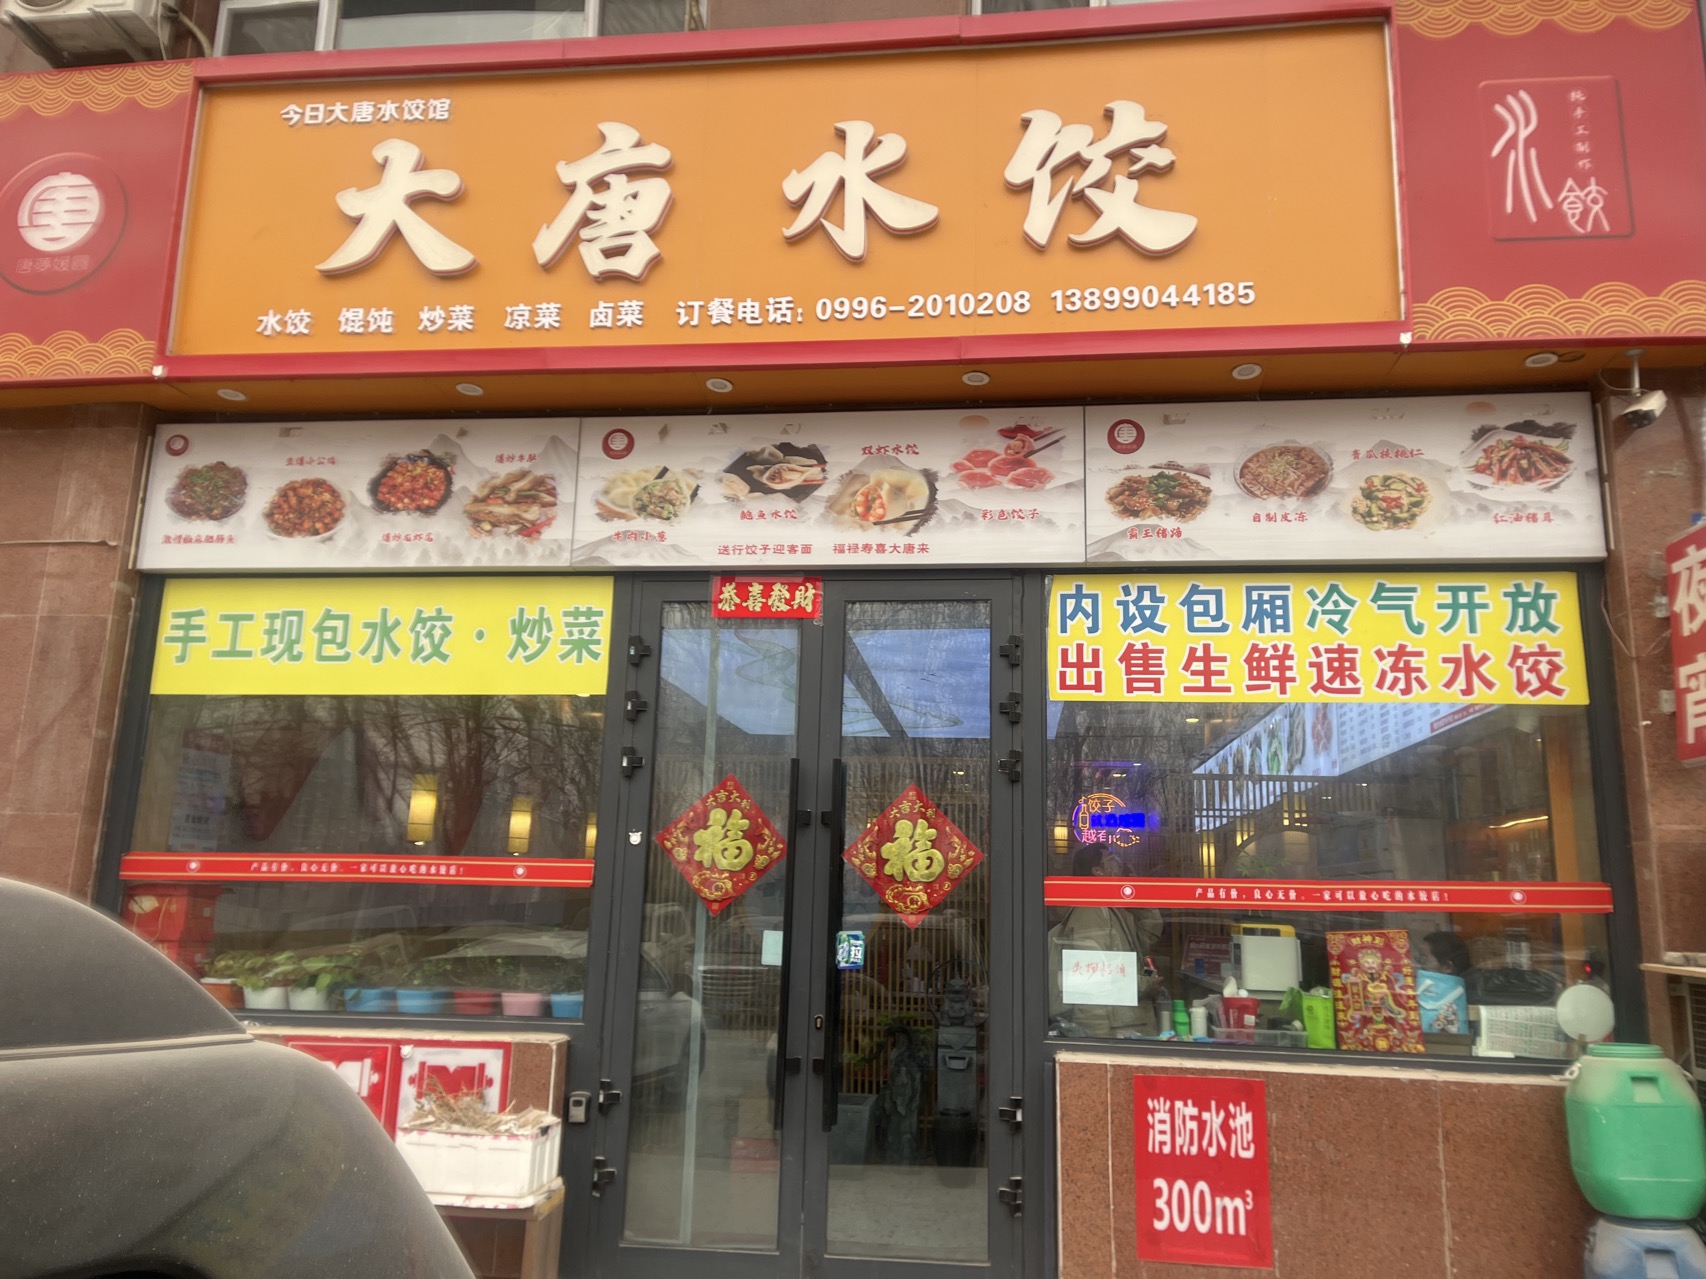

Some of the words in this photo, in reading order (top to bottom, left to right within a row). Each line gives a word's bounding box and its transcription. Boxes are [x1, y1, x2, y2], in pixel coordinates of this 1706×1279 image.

[280, 98, 451, 126] 今日大唐水饺馆
[315, 101, 1198, 282] 大唐水饺
[256, 308, 312, 337] 水饺
[338, 306, 395, 335] 馄饨
[418, 304, 475, 333] 炒菜
[504, 302, 561, 331] 凉菜
[588, 300, 644, 328] 卤菜
[1050, 281, 1257, 314] 13899044185
[860, 443, 920, 456] 双虾水饺
[739, 509, 798, 522] 鲍鱼水饺
[980, 508, 1040, 521] 彩色饺子
[1252, 511, 1308, 523] 自制皮冻
[1492, 511, 1555, 525] 红油猪耳
[611, 530, 668, 543] 牛肉小葱
[717, 543, 814, 556] 送行饺子迎客面
[832, 542, 931, 555] 福禄寿喜大唐来
[717, 581, 816, 613] 恭喜發財
[1058, 580, 1561, 636] 内设包厢冷气开放
[1058, 641, 1568, 698] 出售生鲜速冻水饺
[705, 789, 751, 810] 大吉大利
[889, 799, 936, 820] 大吉大利
[1087, 799, 1116, 814] 饺子
[693, 807, 754, 872] 福
[880, 818, 945, 883] 福
[1147, 1096, 1256, 1160] 消防水池
